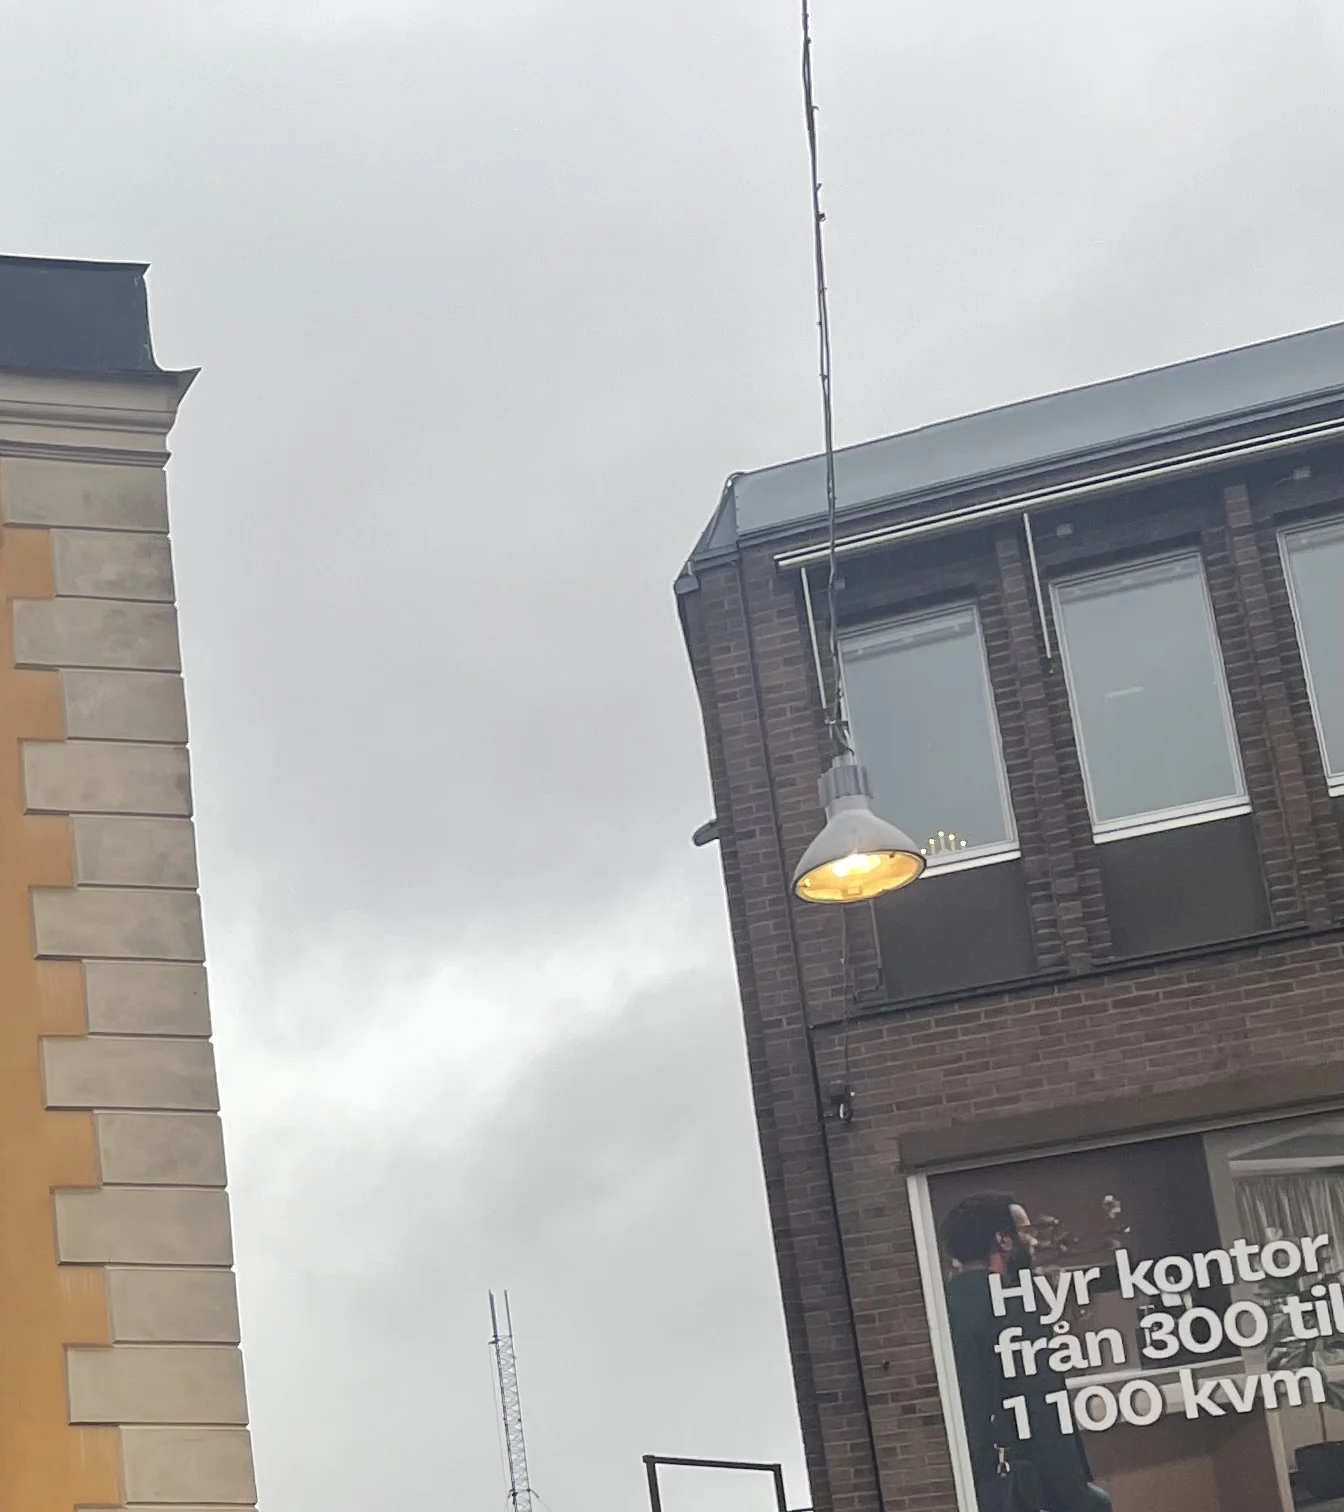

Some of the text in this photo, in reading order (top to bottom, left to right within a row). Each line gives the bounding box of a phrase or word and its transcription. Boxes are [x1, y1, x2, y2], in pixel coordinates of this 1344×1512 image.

[988, 1233, 1329, 1325] Hyr kontor
[994, 1283, 1344, 1379] från 300 til
[1003, 1366, 1326, 1440] 1 100 kvm
